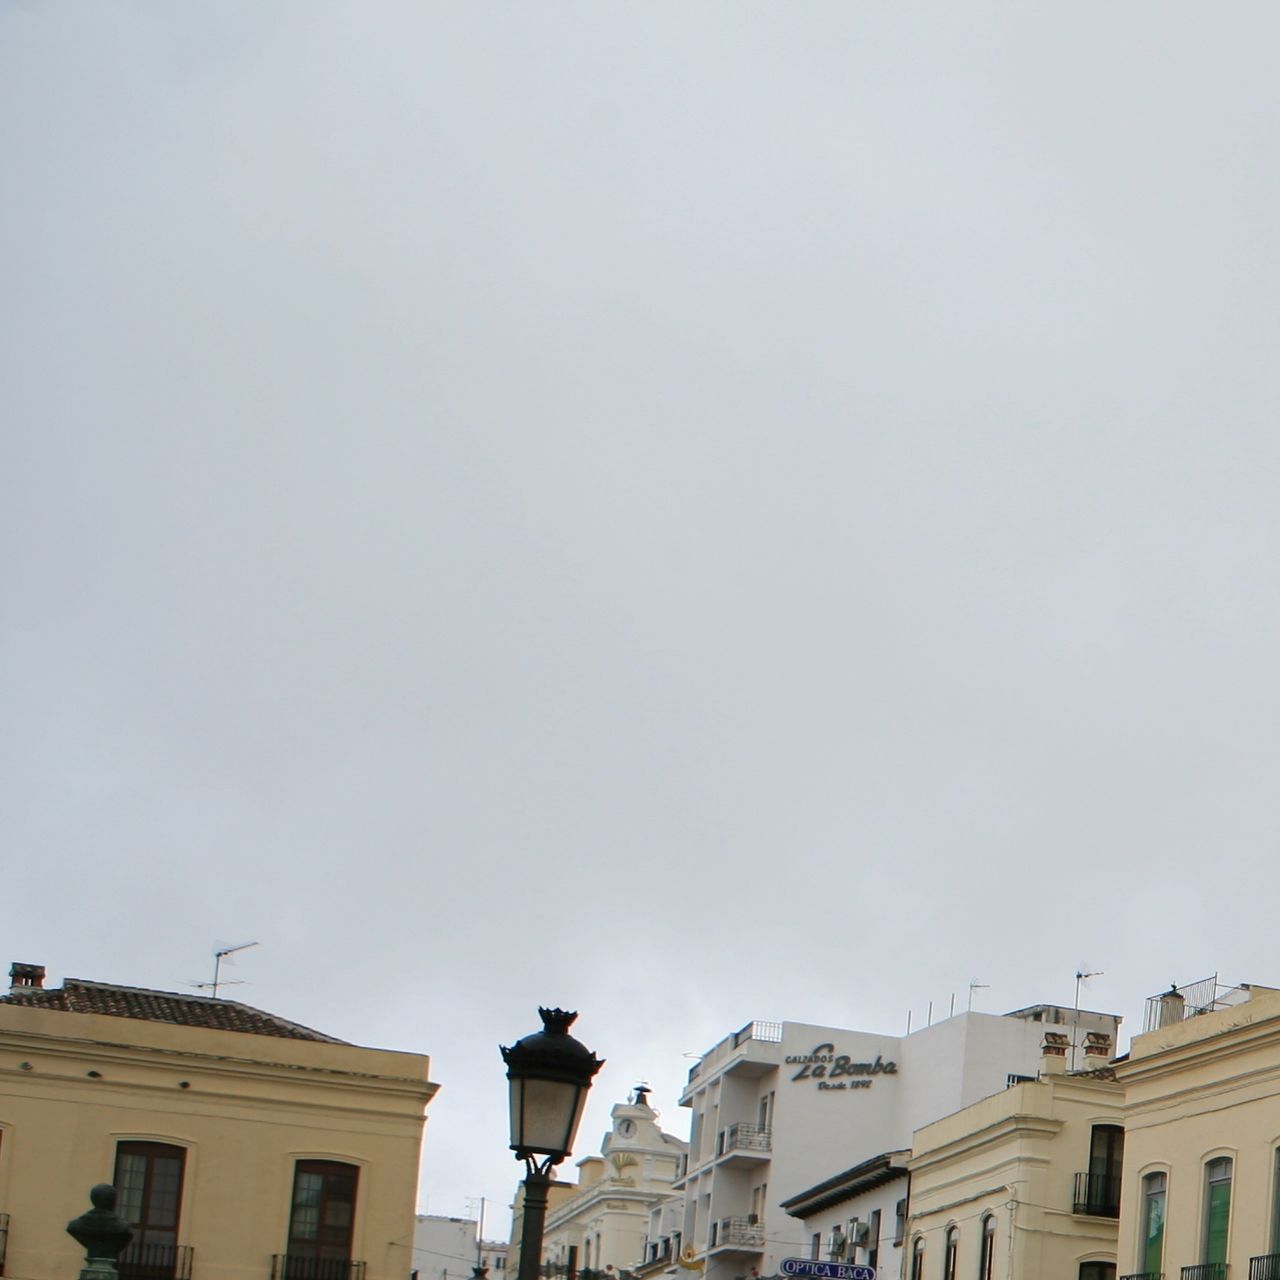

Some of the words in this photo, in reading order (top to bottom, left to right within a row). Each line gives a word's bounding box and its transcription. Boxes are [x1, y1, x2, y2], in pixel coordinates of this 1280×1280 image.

[785, 1055, 834, 1064] CALZADOS
[829, 1055, 898, 1078] Bomba
[785, 1261, 831, 1277] OPTICA
[837, 1266, 870, 1280] BACA
